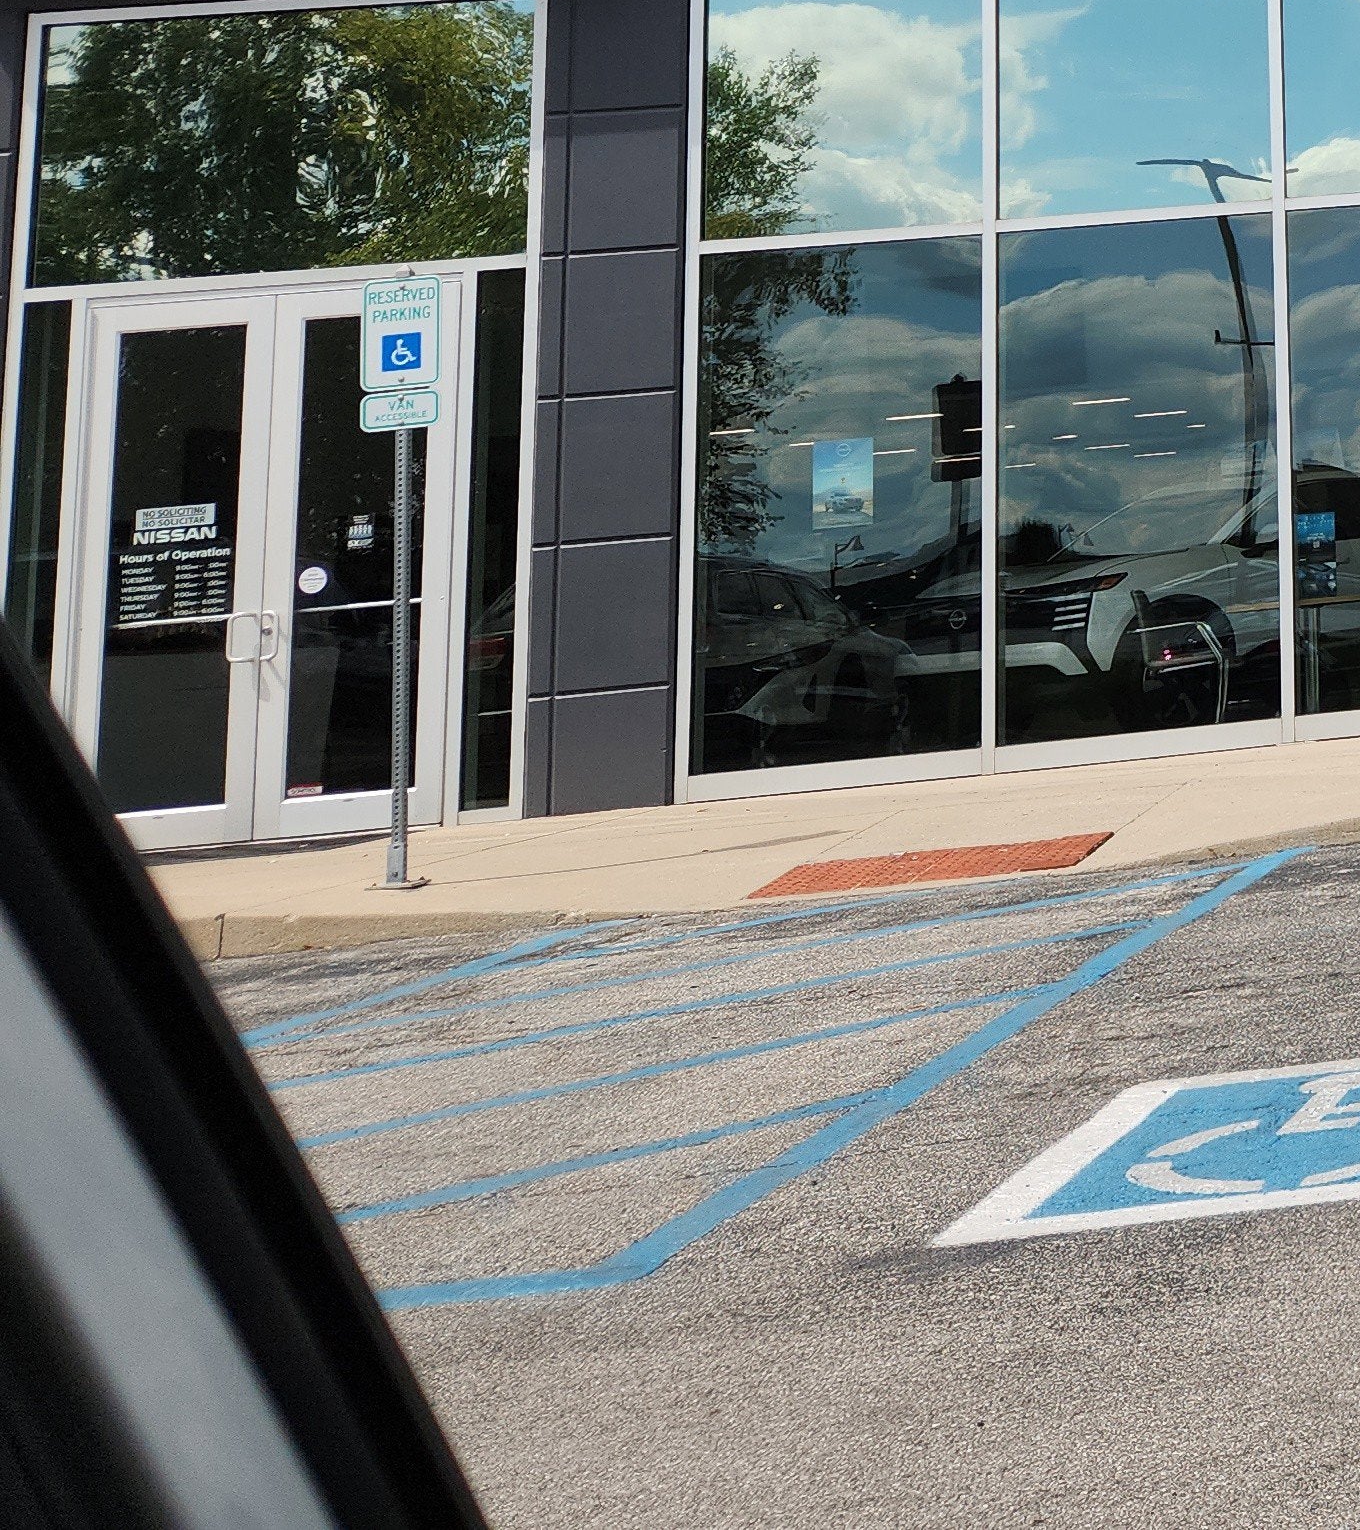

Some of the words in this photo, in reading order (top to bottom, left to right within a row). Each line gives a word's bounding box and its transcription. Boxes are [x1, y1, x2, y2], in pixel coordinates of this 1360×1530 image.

[367, 286, 436, 306] RESERVED
[372, 305, 431, 324] PARKING
[388, 399, 415, 412] VAN
[374, 409, 428, 423] ACCESSIBLE
[142, 510, 156, 520] NO
[157, 505, 207, 518] SOLICITING
[142, 520, 156, 529] NO
[157, 515, 206, 527] SOLICITAR
[132, 525, 218, 546] NISSAN
[119, 553, 155, 565] Hours
[156, 550, 171, 562] of
[171, 546, 232, 562] Operation
[119, 611, 159, 622] SATURDAY
